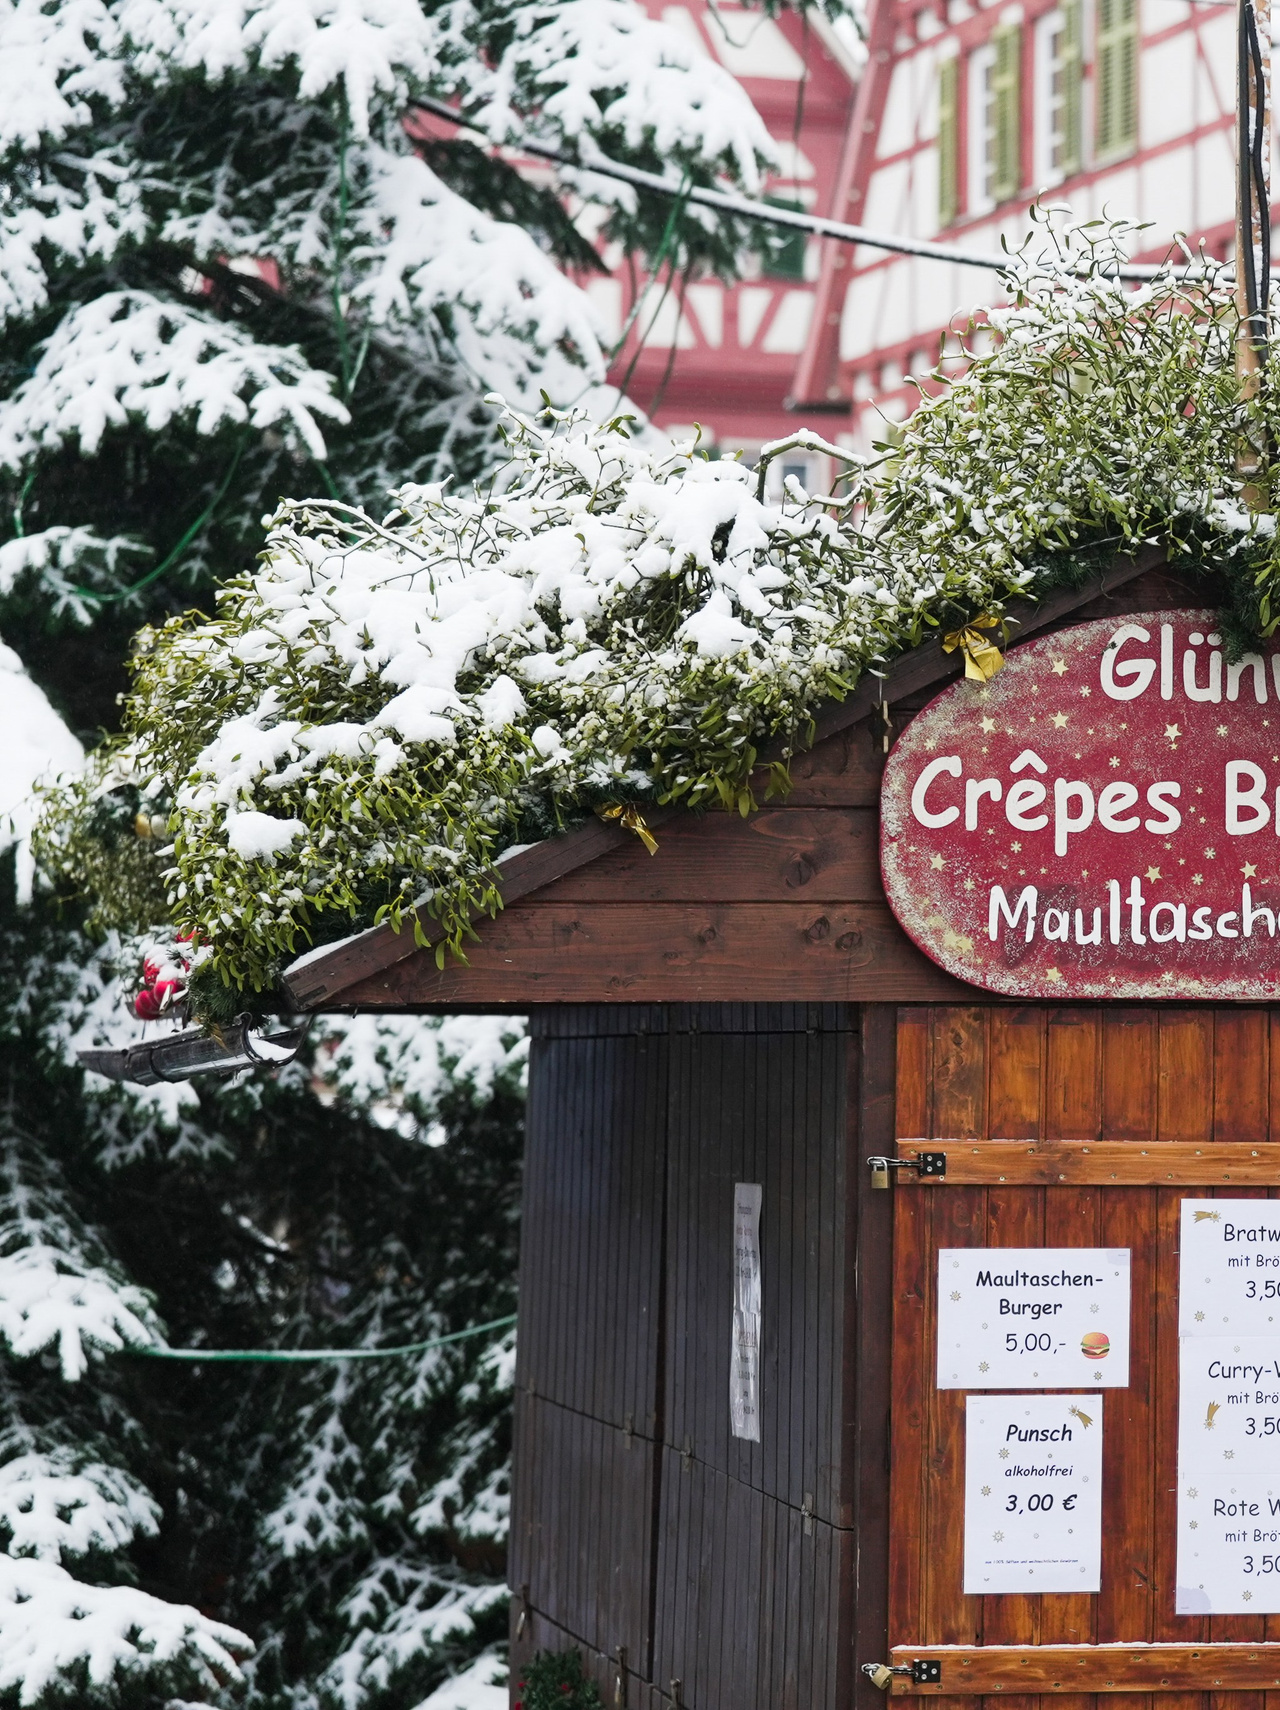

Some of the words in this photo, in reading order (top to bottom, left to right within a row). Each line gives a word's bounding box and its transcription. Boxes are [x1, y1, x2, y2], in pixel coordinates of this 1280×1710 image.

[911, 748, 1182, 857] Crêpes
[1228, 1255, 1251, 1268] mit
[975, 1270, 1104, 1287] Maultaschen-
[999, 1298, 1063, 1320] Burger
[1005, 1332, 1067, 1355] 5,00,-
[1227, 1392, 1250, 1405] mit
[1005, 1423, 1073, 1443] Punsch
[1004, 1465, 1074, 1477] alkoholfrei
[1005, 1493, 1054, 1515] 3,00
[1062, 1493, 1078, 1511] €
[1213, 1498, 1260, 1517] Rote
[1225, 1530, 1248, 1543] mit
